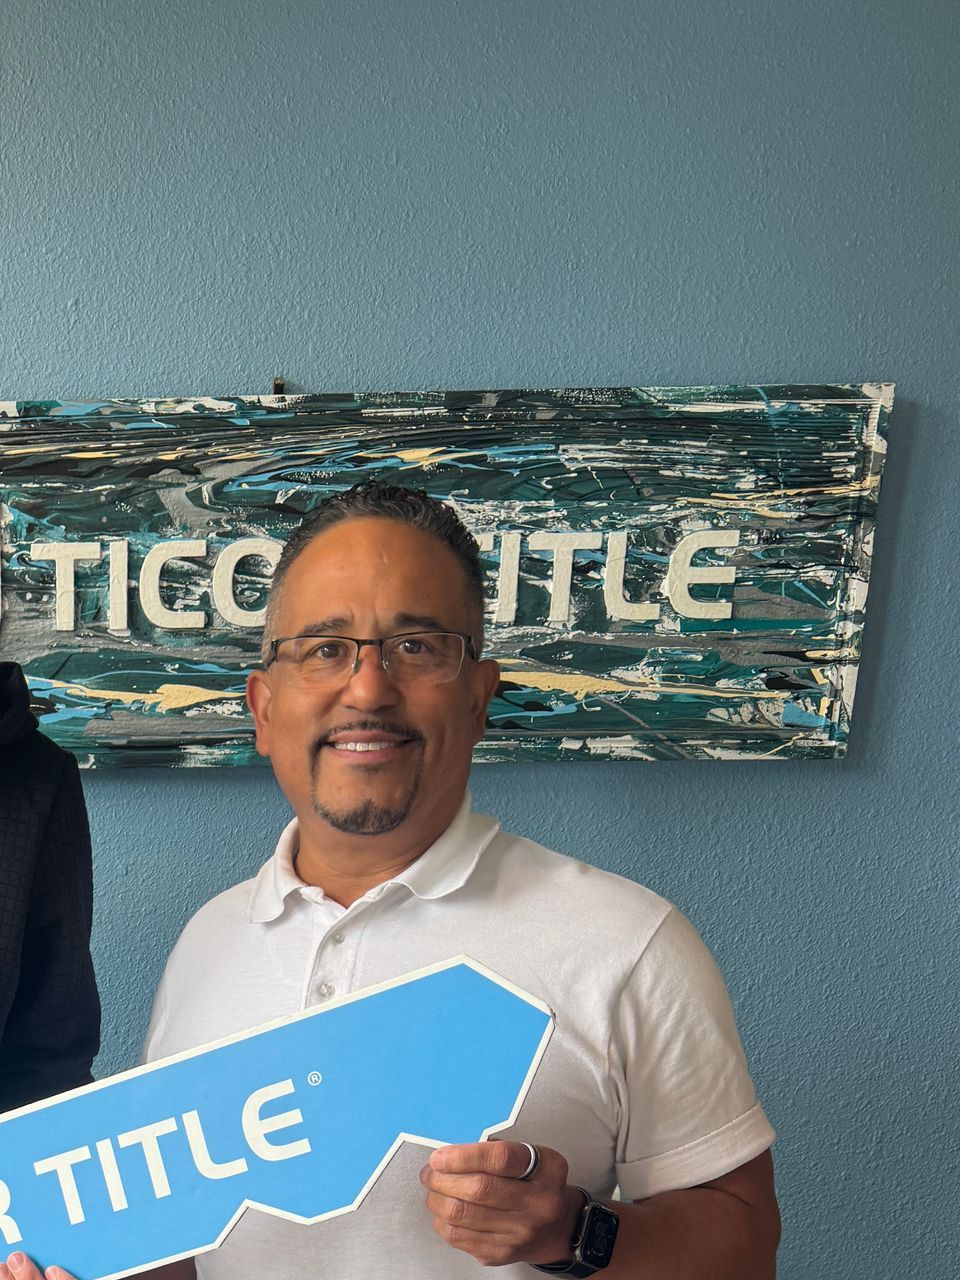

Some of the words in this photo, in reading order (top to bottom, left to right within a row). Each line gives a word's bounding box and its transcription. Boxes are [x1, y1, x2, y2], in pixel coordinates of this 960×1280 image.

[30, 538, 285, 632] TICO
[474, 529, 741, 623] ITLE
[33, 1078, 312, 1226] TITLE
